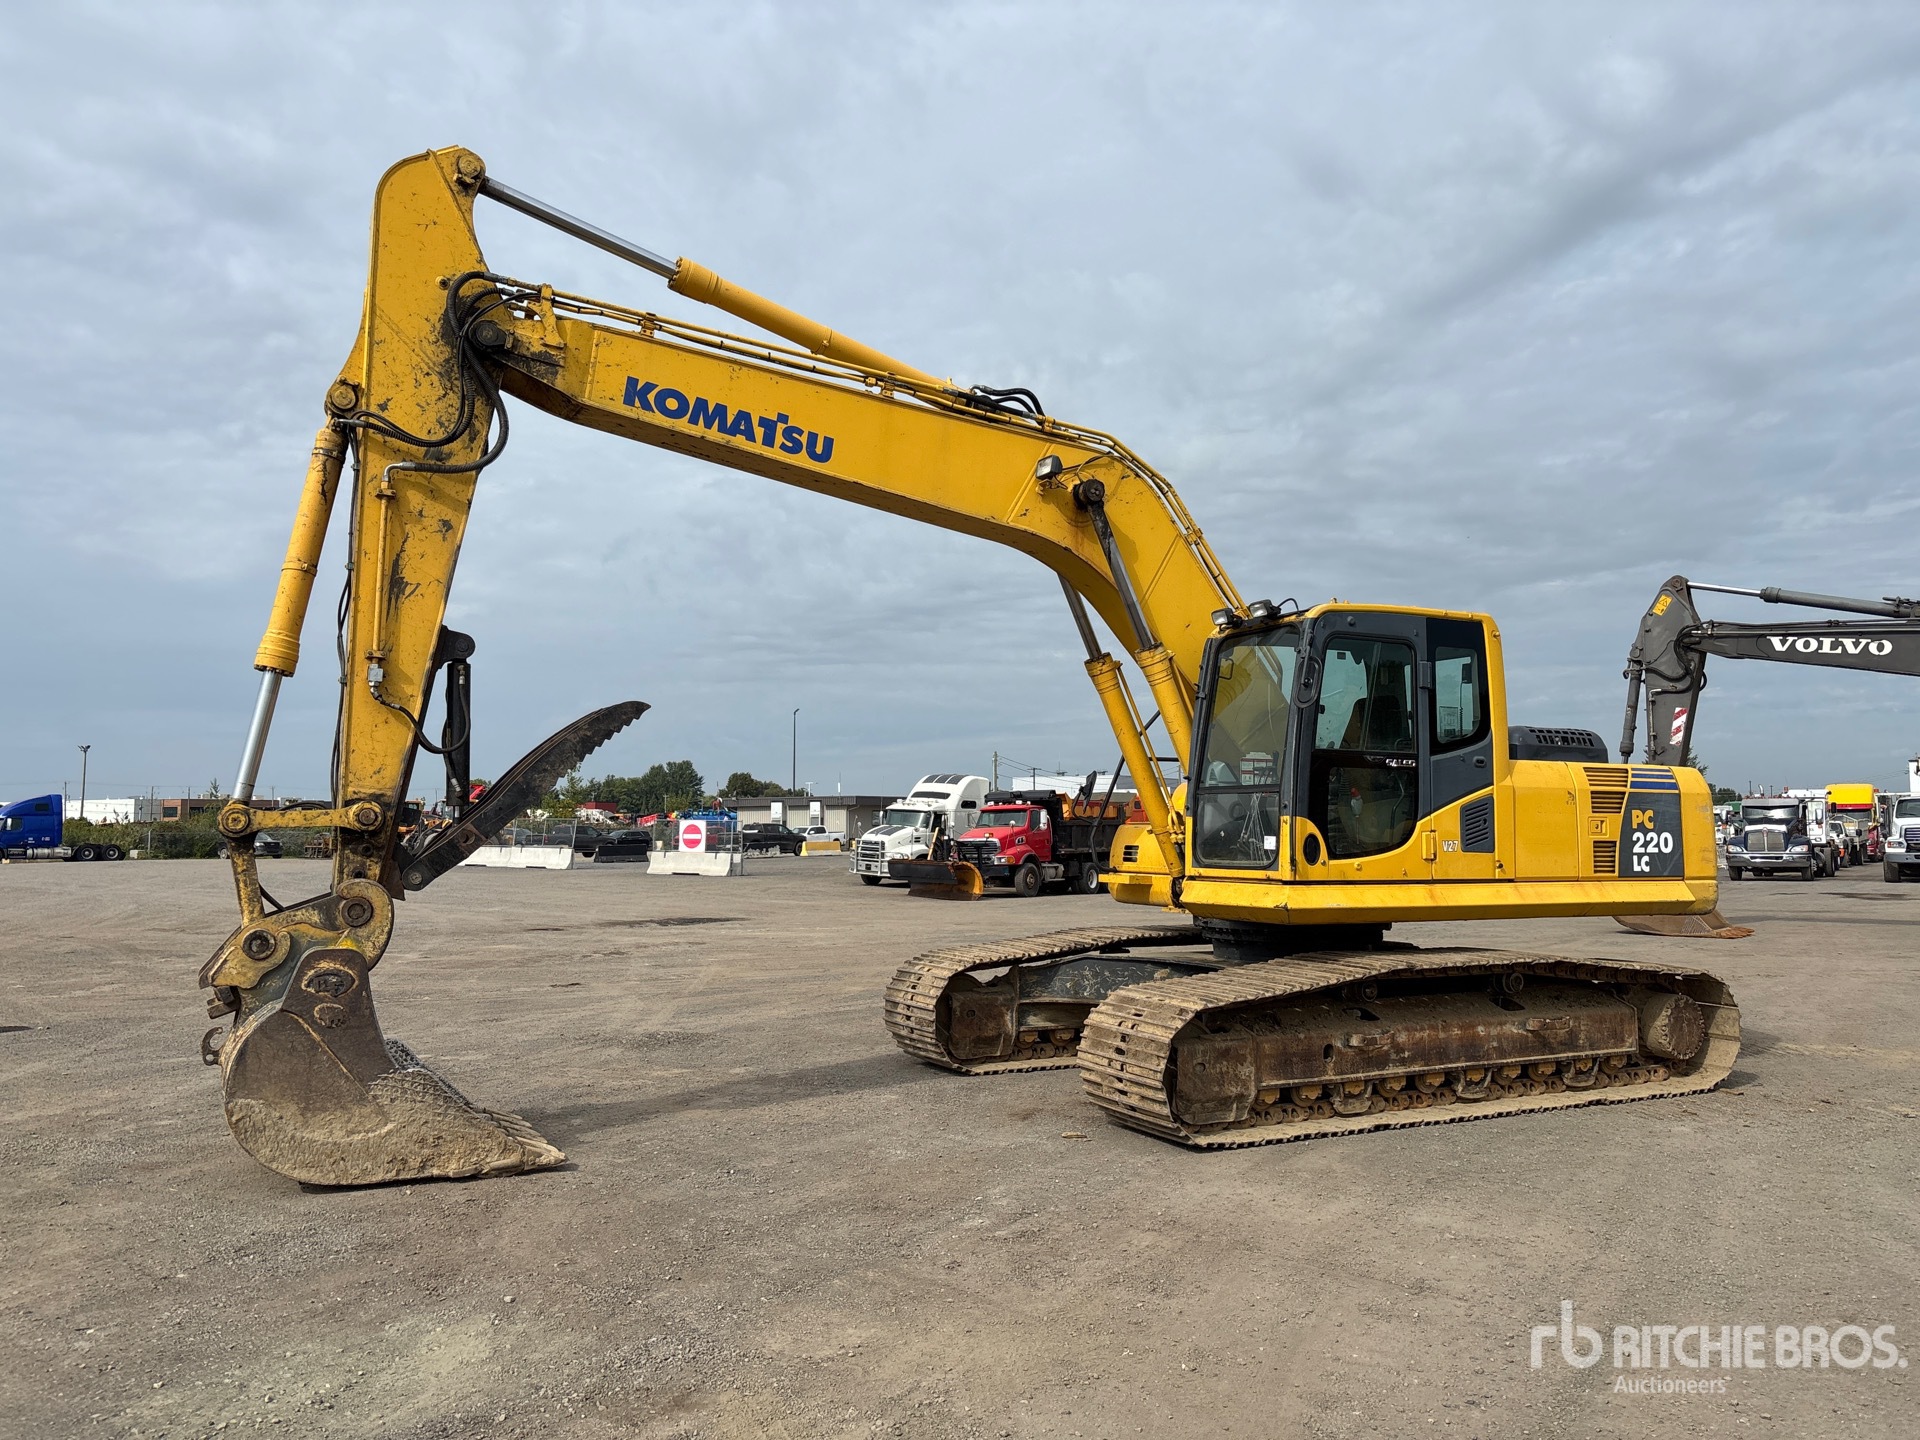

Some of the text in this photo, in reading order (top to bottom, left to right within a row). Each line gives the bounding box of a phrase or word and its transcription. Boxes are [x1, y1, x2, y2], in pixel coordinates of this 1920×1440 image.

[622, 375, 835, 464] KOMATSU
[1766, 635, 1893, 656] VOLVO
[1631, 809, 1654, 829] PC
[1442, 840, 1459, 852] V27
[1632, 831, 1674, 854] 220
[1632, 855, 1651, 872] LC
